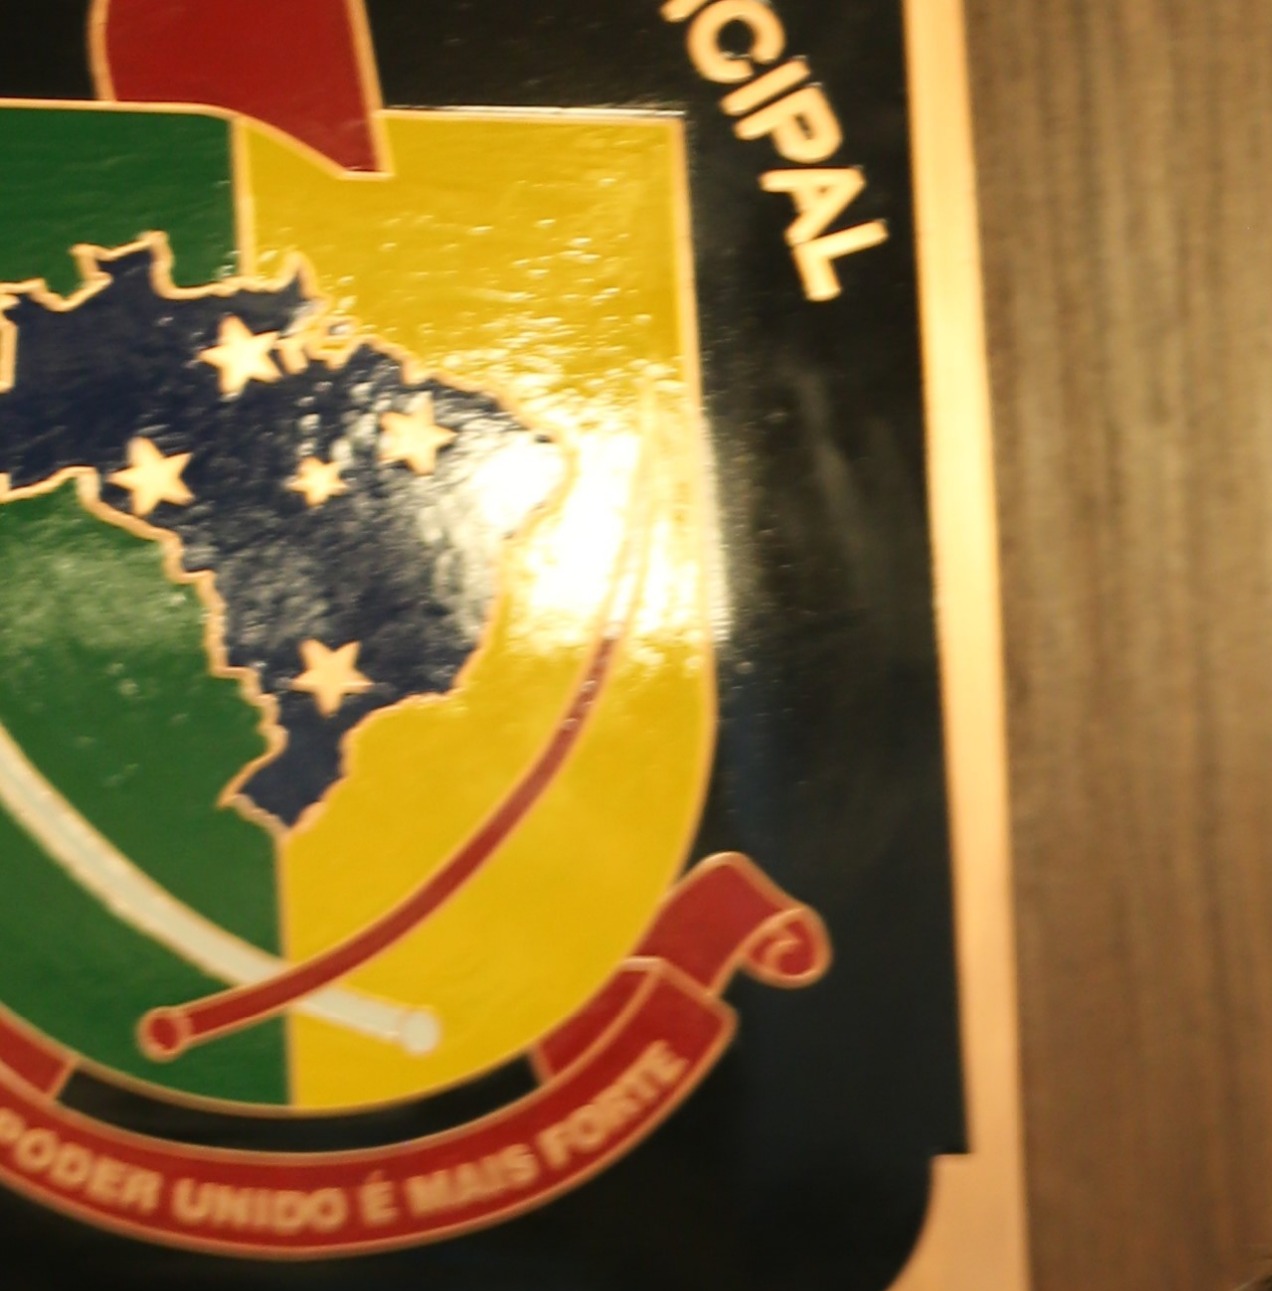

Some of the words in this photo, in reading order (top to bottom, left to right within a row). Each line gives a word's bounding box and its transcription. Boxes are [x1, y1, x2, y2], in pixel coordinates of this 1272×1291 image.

[171, 1176, 349, 1235] UNIDO
[359, 1169, 397, 1225] É
[404, 1144, 537, 1214] MAIS
[537, 1041, 688, 1169] FORTE
